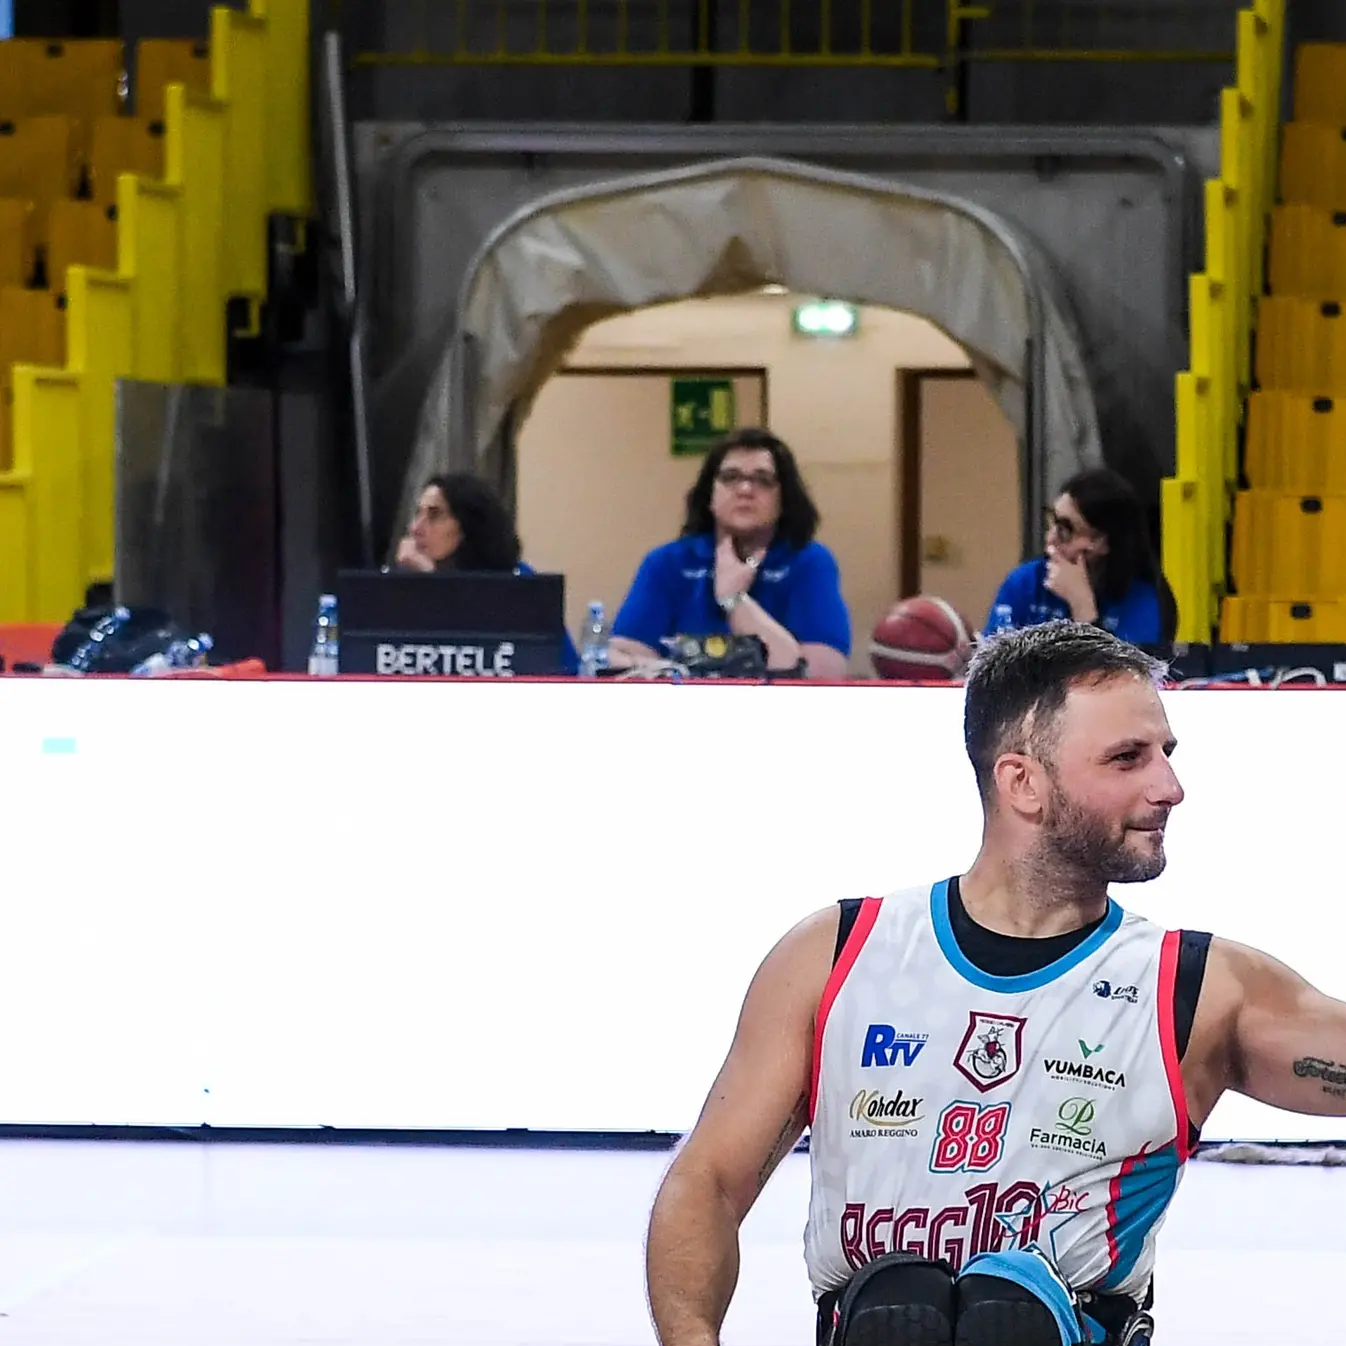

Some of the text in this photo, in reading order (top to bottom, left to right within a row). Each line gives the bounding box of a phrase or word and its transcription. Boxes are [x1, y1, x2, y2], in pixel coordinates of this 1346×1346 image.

[1043, 1059, 1126, 1088] VUMBACA
[850, 1128, 919, 1138] AMARO REGGINO
[929, 1099, 1012, 1174] 88
